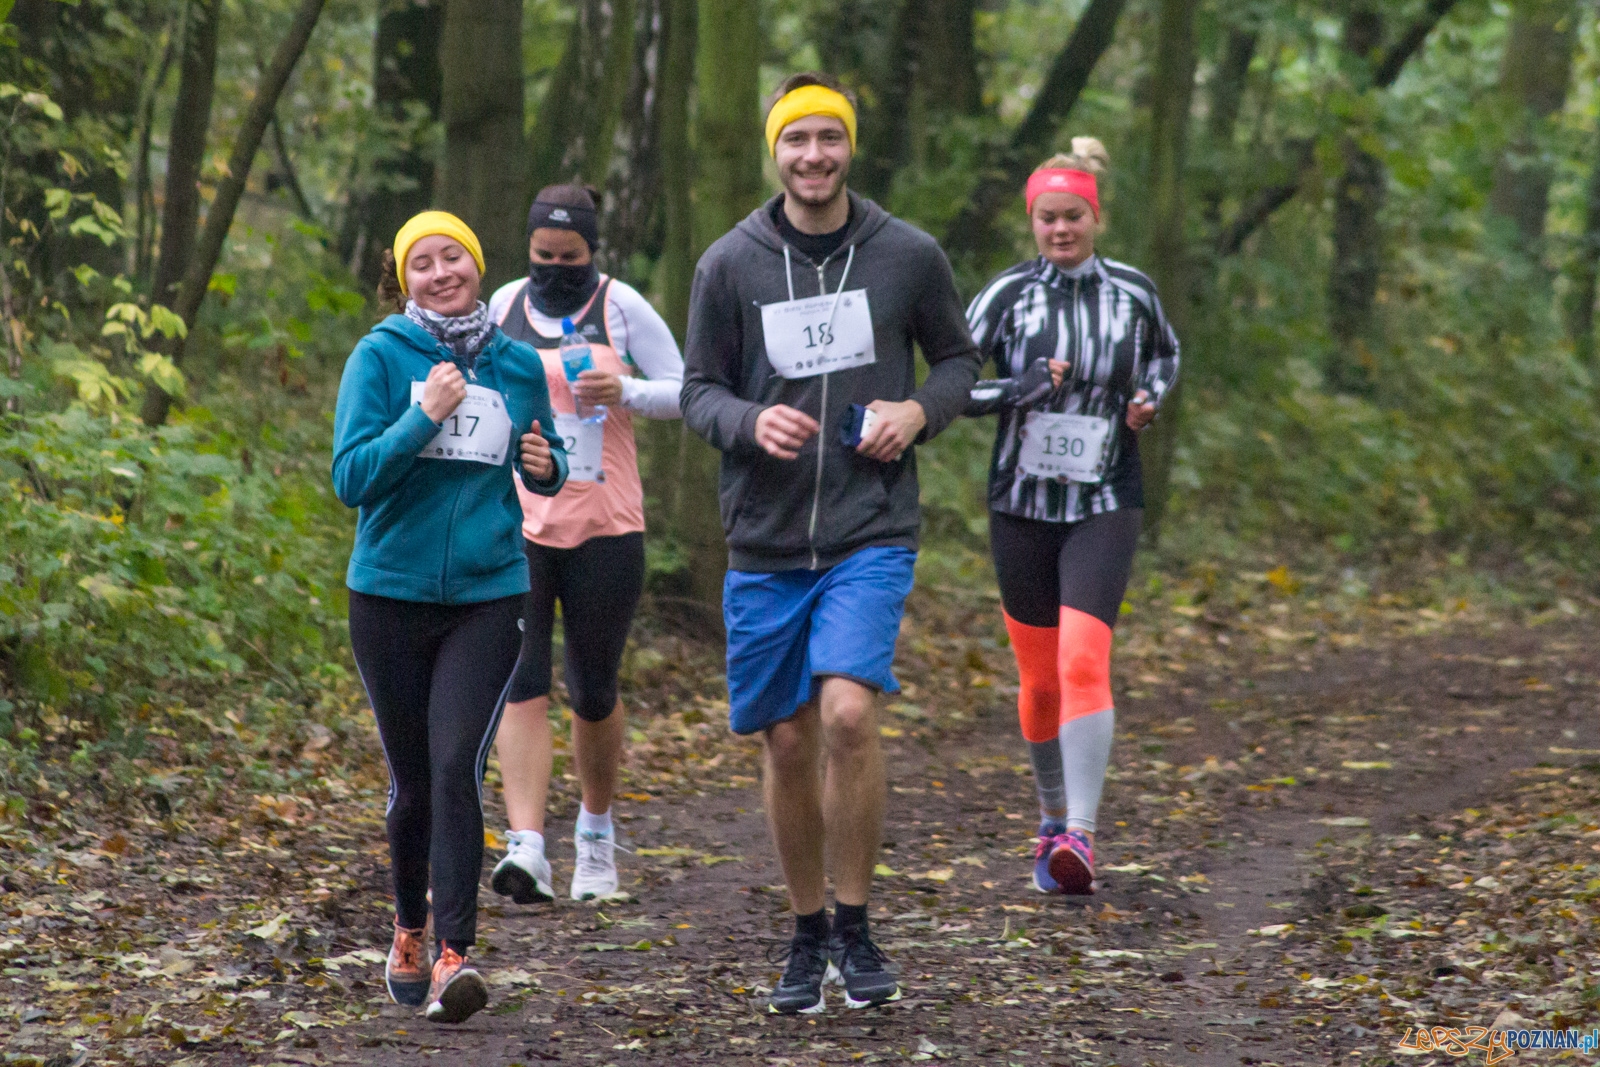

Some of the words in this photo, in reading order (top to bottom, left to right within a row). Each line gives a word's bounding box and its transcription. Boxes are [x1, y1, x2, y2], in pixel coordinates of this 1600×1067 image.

[802, 322, 835, 349] 18
[449, 414, 480, 437] 17
[1042, 434, 1085, 458] 130
